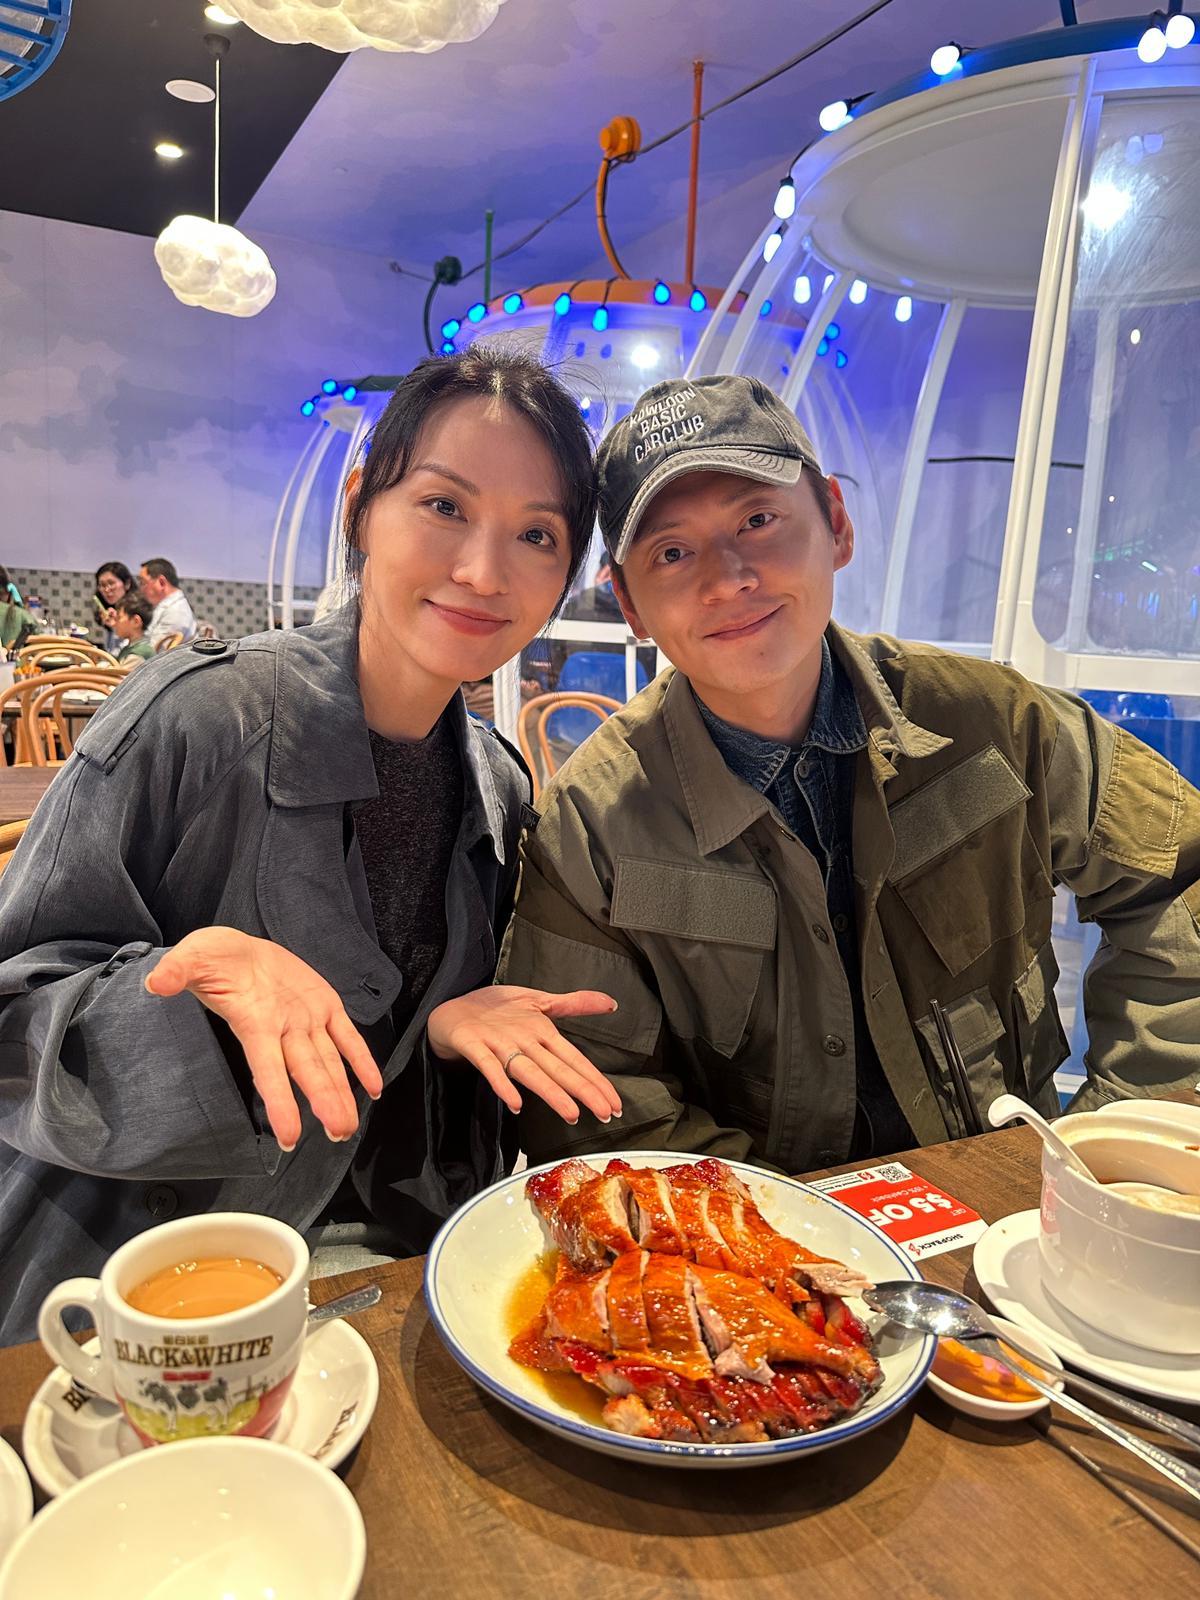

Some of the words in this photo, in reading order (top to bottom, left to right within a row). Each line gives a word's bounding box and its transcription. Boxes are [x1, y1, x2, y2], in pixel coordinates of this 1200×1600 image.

[629, 386, 696, 428] KOWLOON
[640, 404, 687, 438] BASIC
[634, 414, 704, 462] CARCLUB
[868, 1203, 914, 1227] OF
[908, 1192, 953, 1213] $5
[918, 1233, 964, 1250] SHOPBACK
[114, 1335, 274, 1368] BLACK&WHITE
